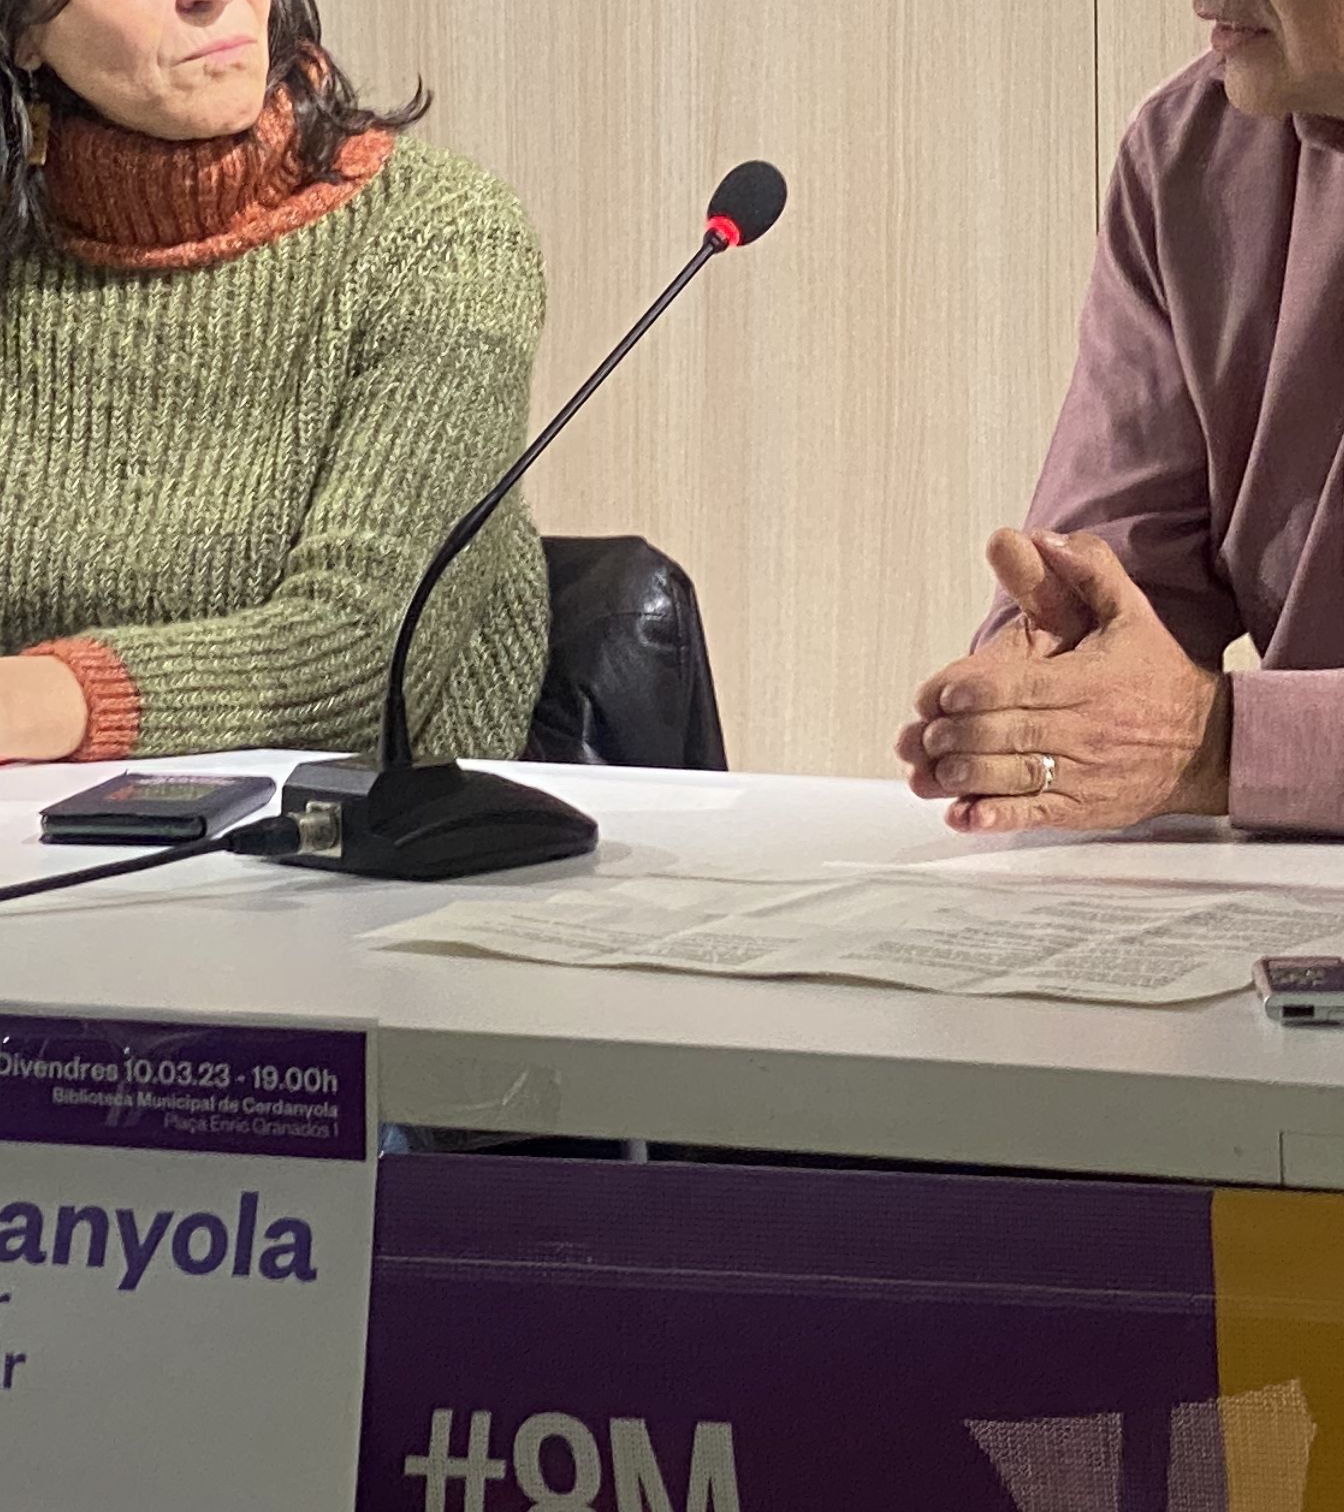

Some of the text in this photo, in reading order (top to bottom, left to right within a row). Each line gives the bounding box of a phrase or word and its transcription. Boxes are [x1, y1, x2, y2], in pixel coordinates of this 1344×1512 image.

[124, 1057, 231, 1088] 10.03.23
[252, 1064, 339, 1096] 19.00h
[52, 1087, 339, 1120] Biblioteca Municipal de Cerdanyola
